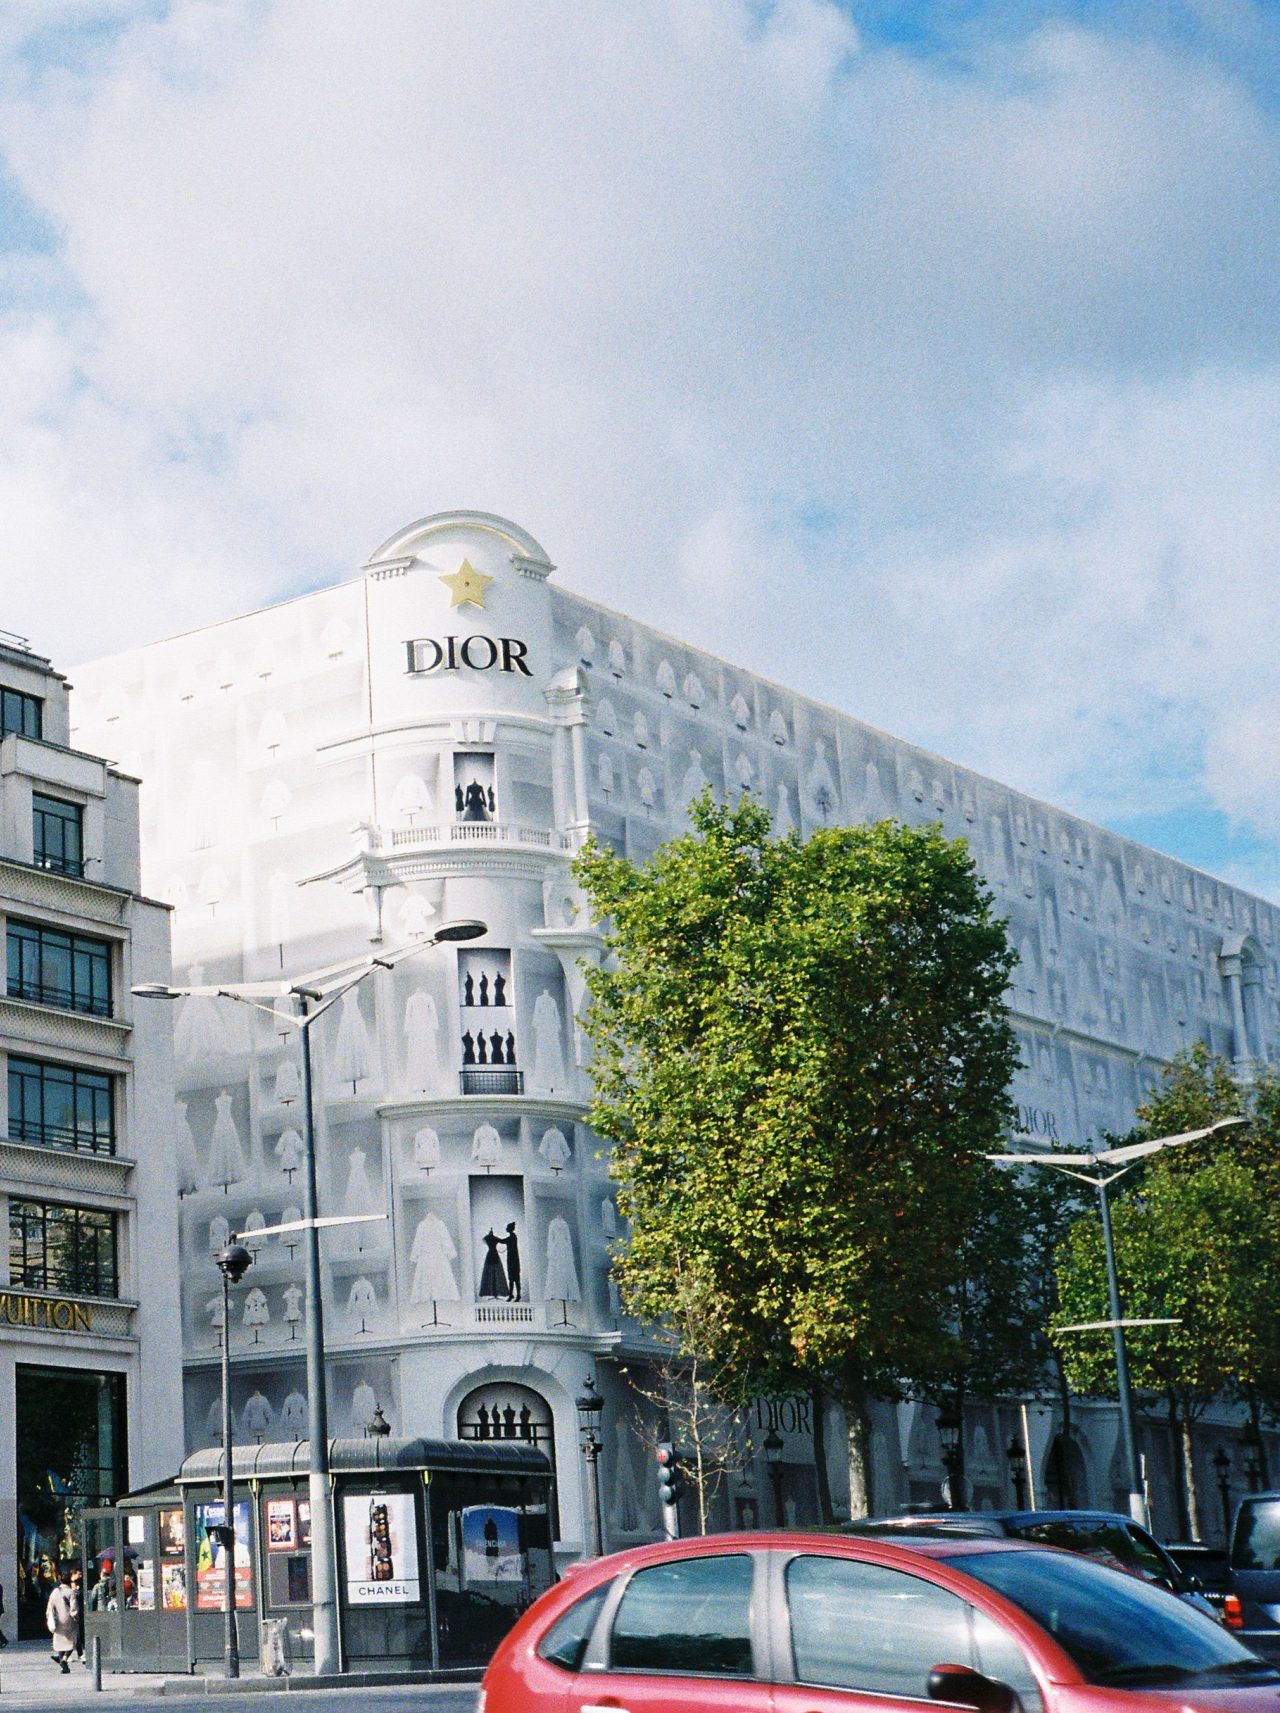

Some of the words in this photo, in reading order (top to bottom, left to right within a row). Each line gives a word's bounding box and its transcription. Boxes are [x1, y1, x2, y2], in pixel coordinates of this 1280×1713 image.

[401, 635, 533, 677] DIOR
[755, 1396, 812, 1435] DIOR
[358, 1585, 410, 1597] CHANEL
